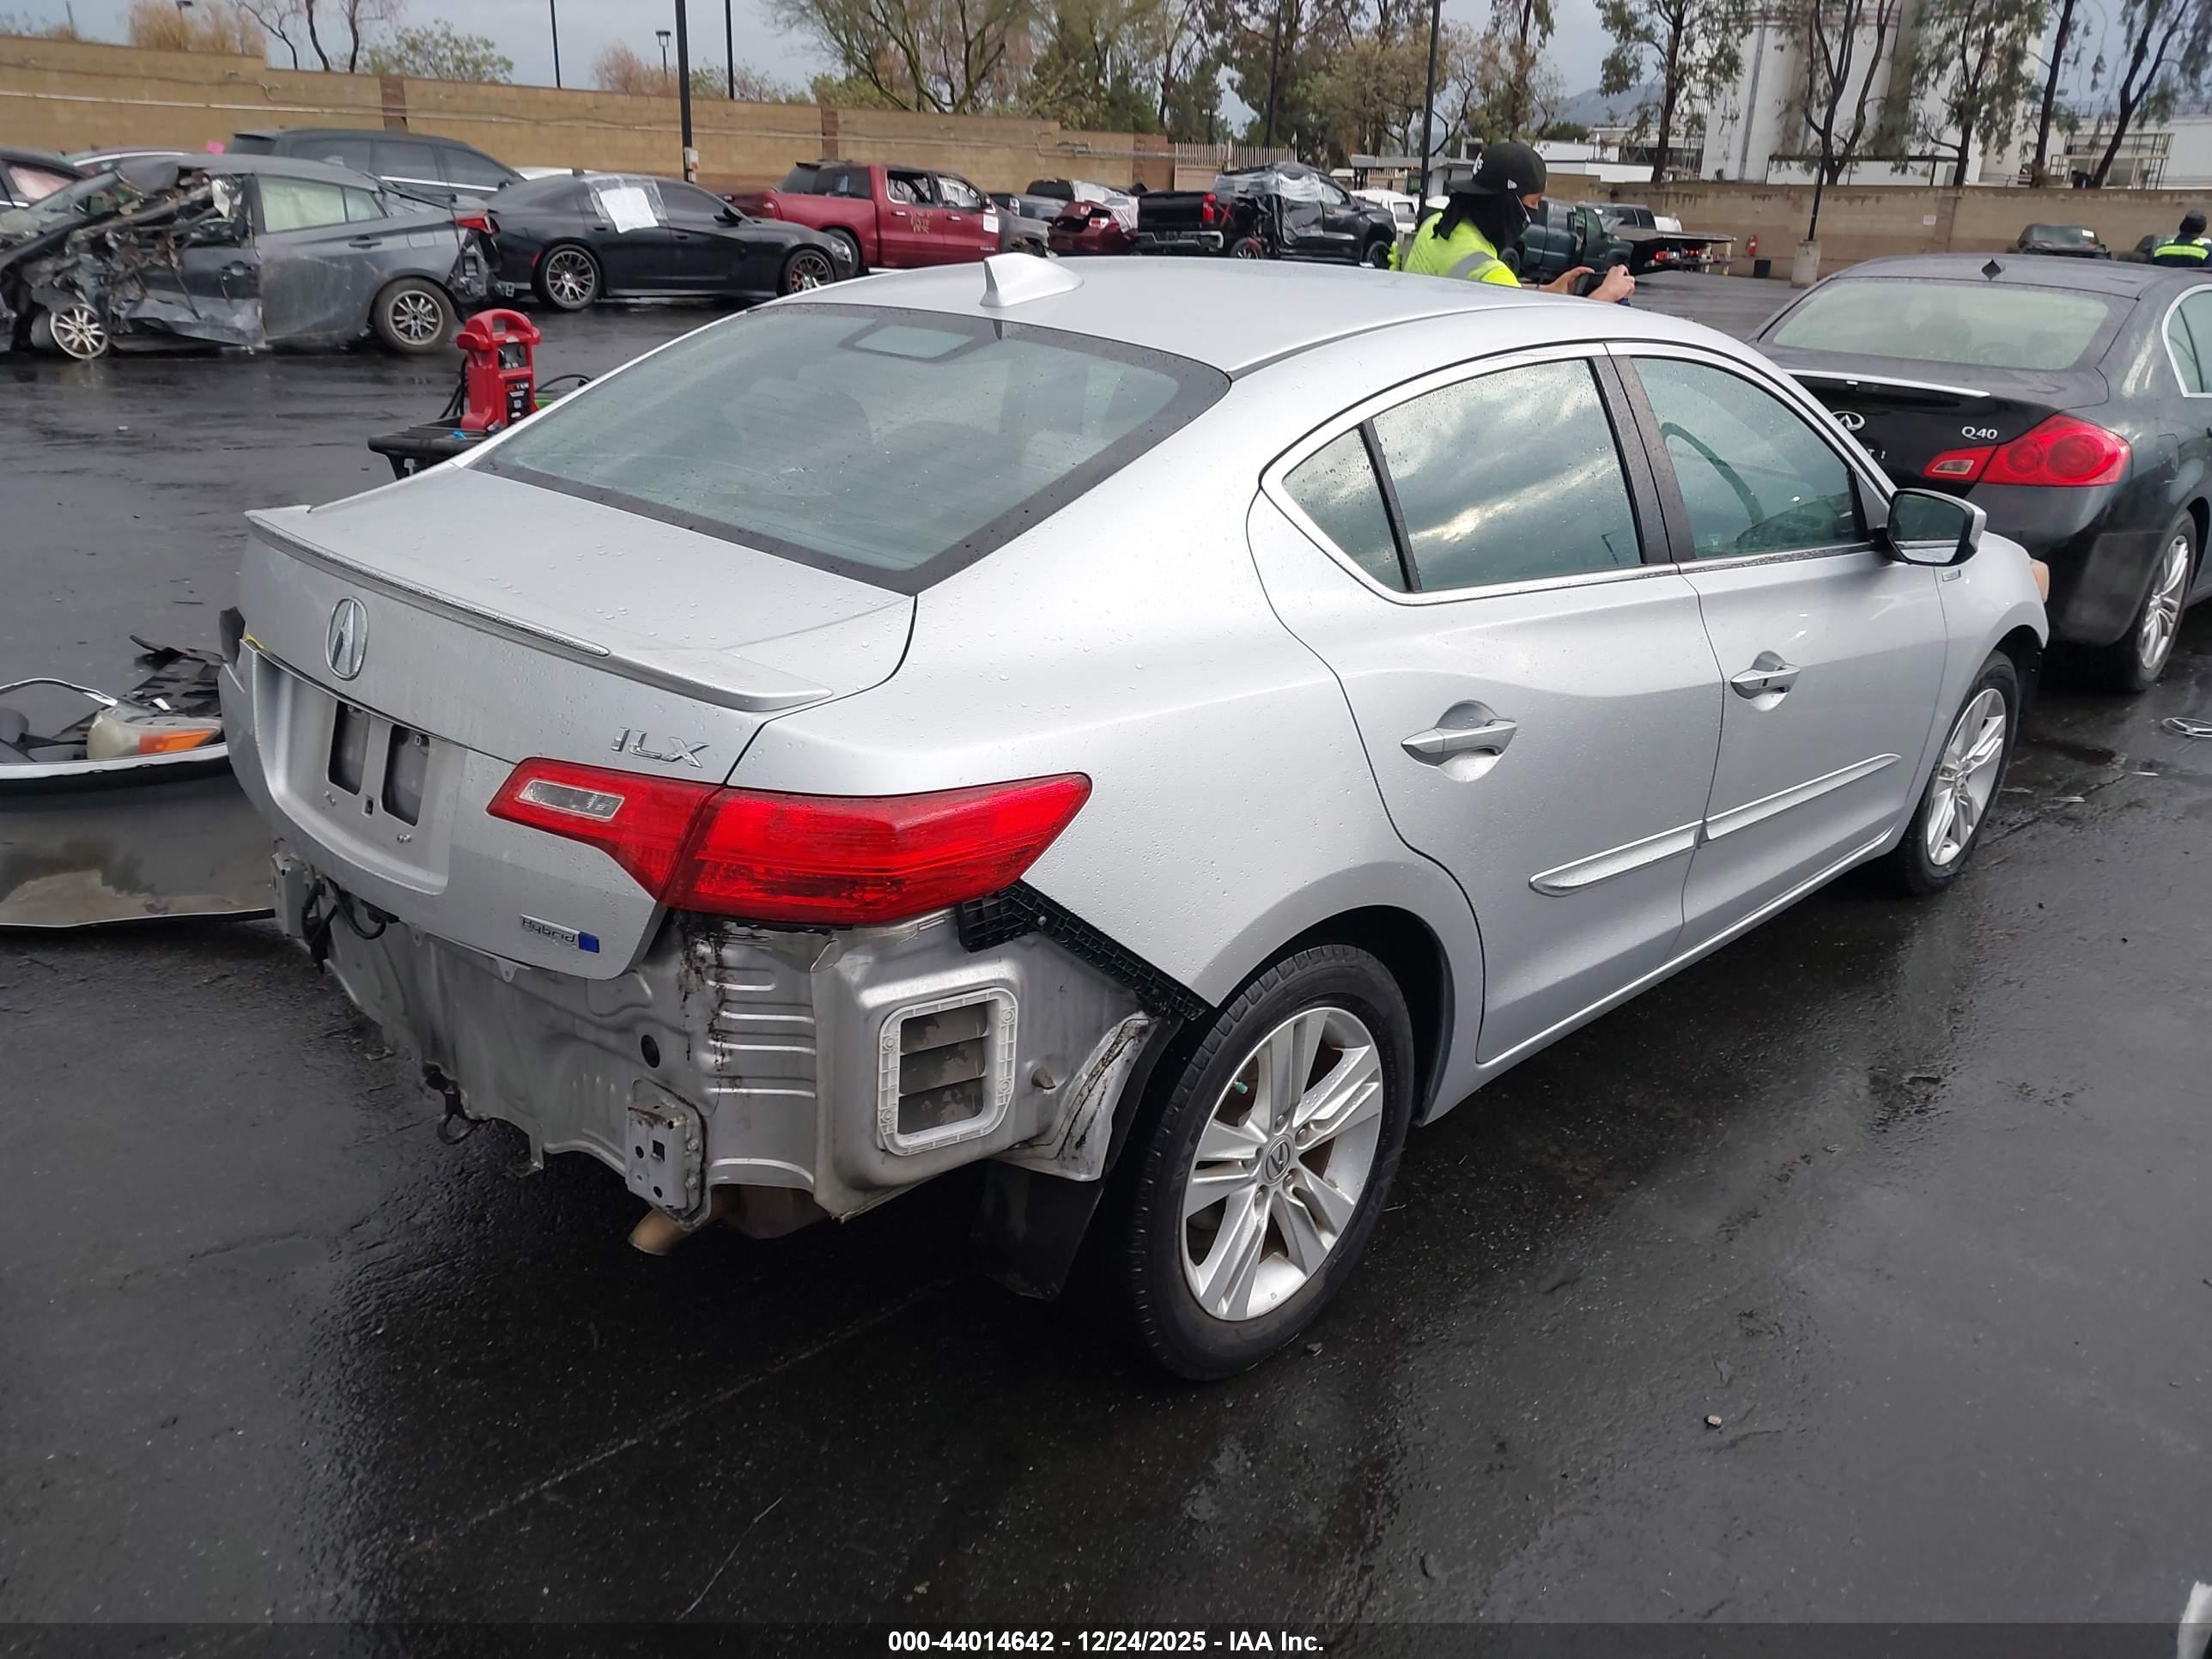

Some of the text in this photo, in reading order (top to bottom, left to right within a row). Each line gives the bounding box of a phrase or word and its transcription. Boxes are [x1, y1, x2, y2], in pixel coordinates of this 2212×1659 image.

[1961, 425, 1998, 441] Q40
[611, 726, 710, 769] ILX
[521, 917, 576, 944] Hybrid
